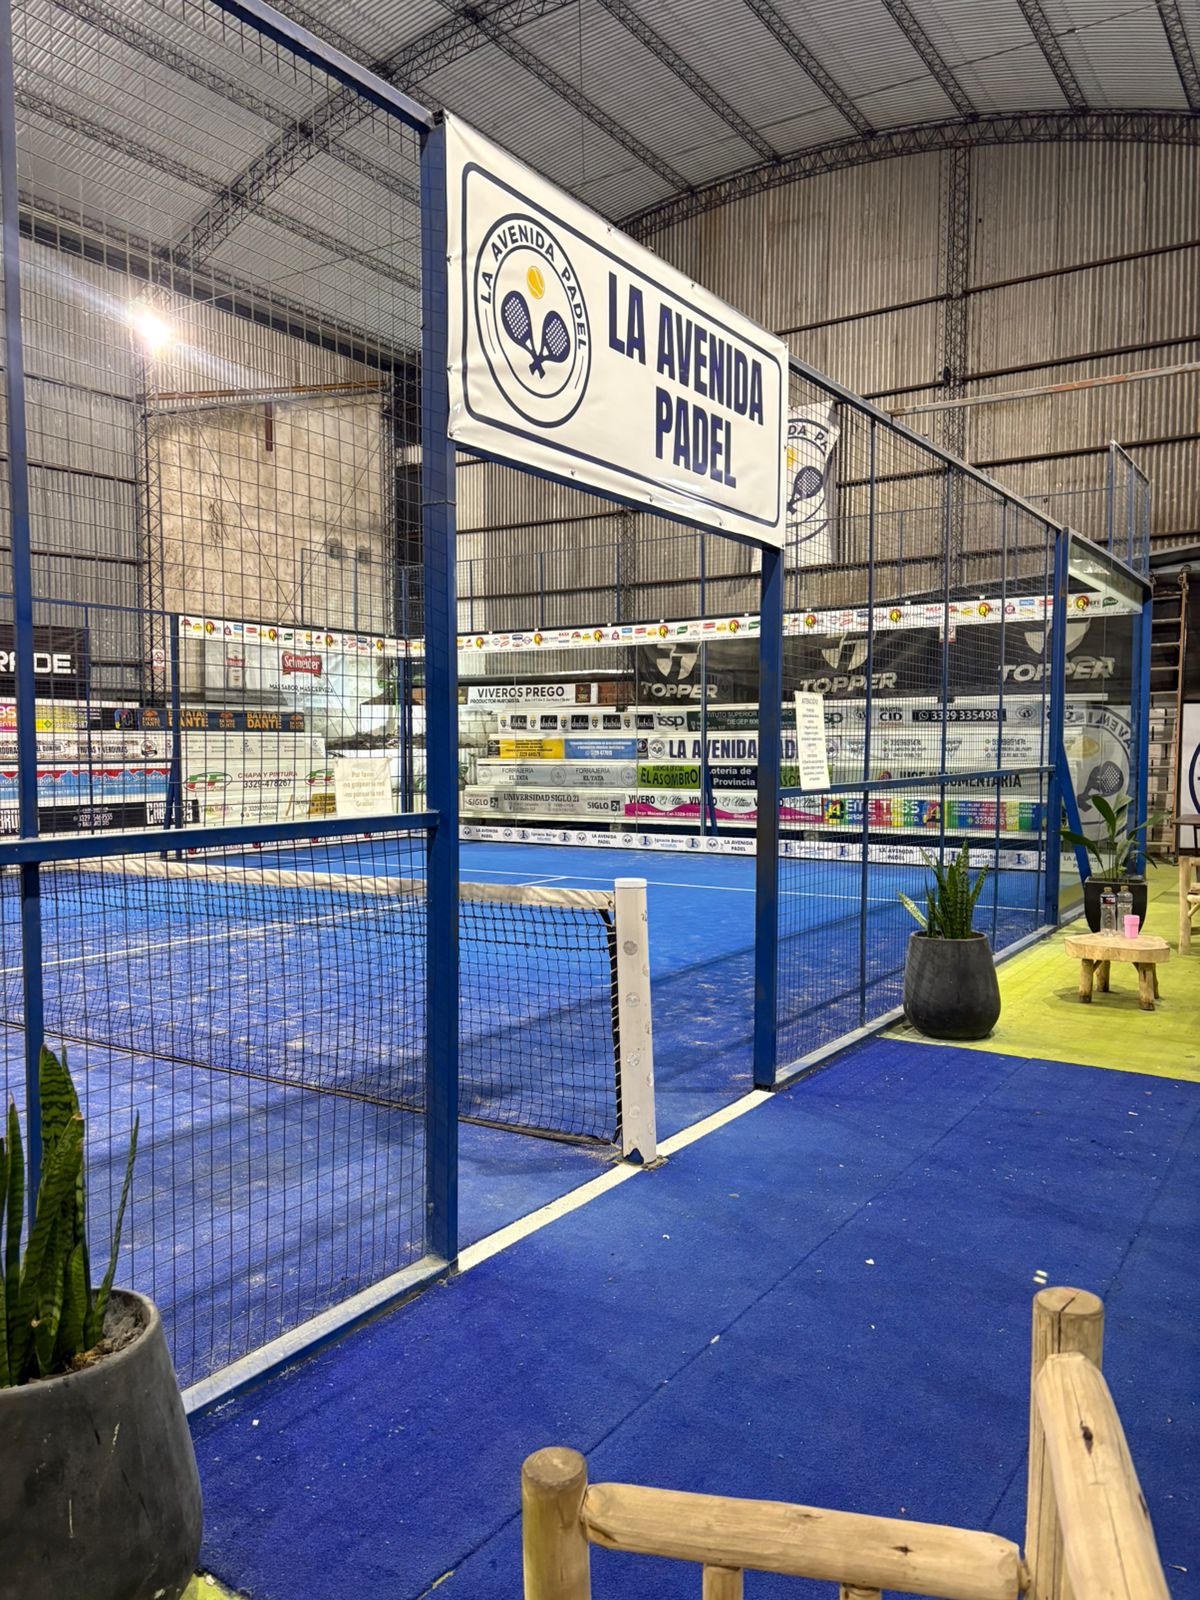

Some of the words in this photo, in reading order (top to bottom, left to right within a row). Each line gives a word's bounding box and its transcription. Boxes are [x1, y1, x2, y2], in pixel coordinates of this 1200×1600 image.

[480, 271, 493, 304] LA
[491, 224, 556, 262] AVENIDA
[560, 266, 586, 350] PADEL
[608, 270, 646, 365] LA
[656, 302, 764, 425] AVENIDA
[655, 385, 737, 489] PADEL
[283, 655, 320, 670] Schneider
[640, 682, 718, 699] TOPPER
[800, 672, 897, 694] TOPPER
[477, 687, 523, 698] VIVEROS
[526, 686, 565, 697] PREGO
[657, 713, 684, 730] issp
[880, 713, 902, 721] CID
[932, 711, 956, 720] 3329
[960, 711, 998, 720] 335498
[247, 719, 282, 729] DANTE
[669, 740, 687, 758] LA
[640, 770, 650, 783] EL
[653, 769, 698, 785] ASOMBRO
[709, 767, 737, 775] otería
[740, 767, 751, 775] de
[713, 778, 756, 786] Provincia
[551, 794, 571, 802] SIGLO
[629, 795, 655, 804] VIVERO
[689, 796, 717, 805] VIVO
